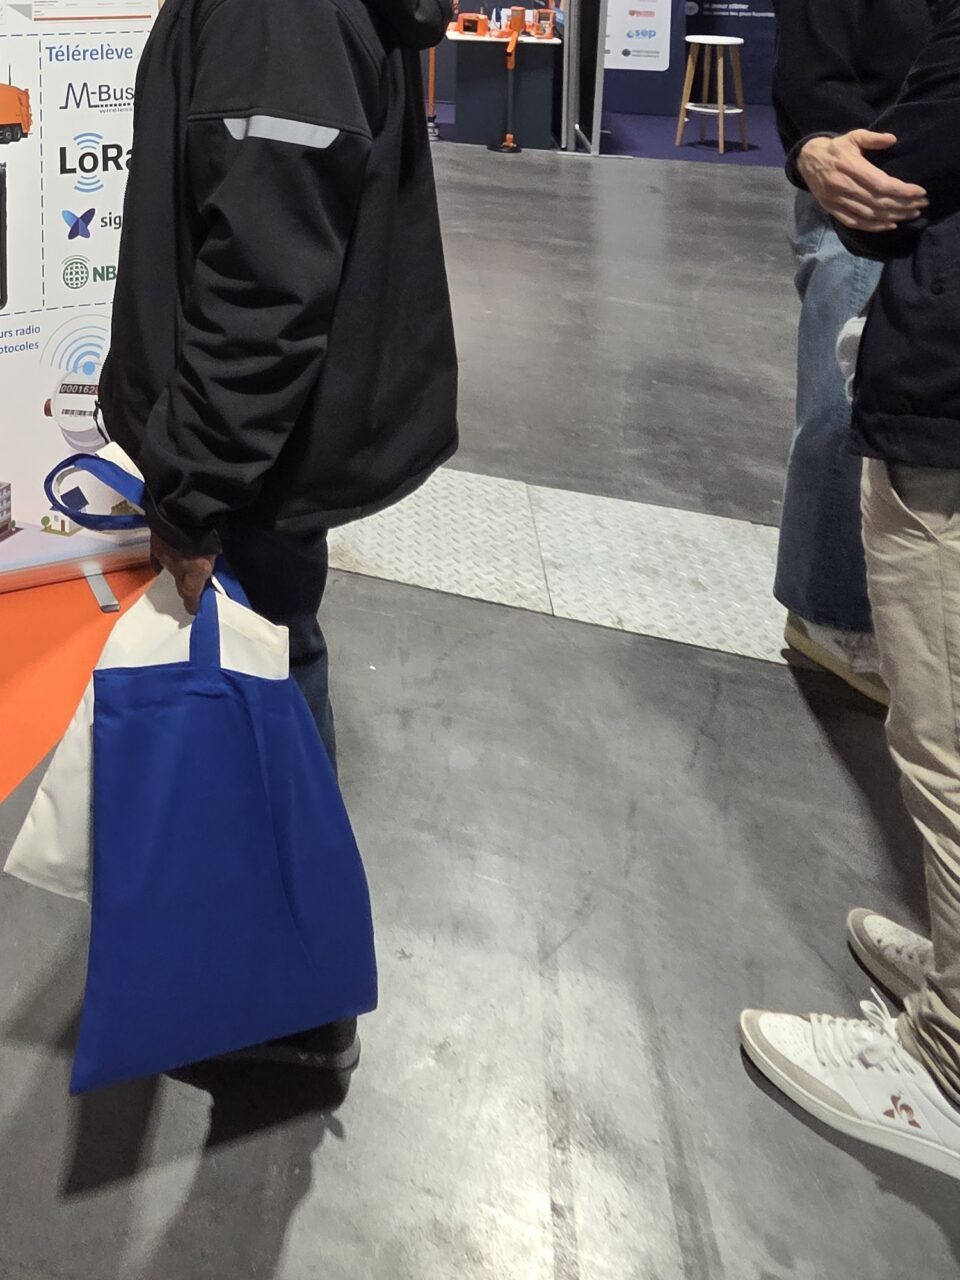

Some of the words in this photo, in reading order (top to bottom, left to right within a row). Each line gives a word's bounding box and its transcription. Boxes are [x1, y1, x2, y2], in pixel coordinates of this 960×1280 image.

[46, 46, 133, 62] Télérelève
[59, 82, 134, 109] M-Bus
[100, 211, 121, 229] sig
[93, 265, 116, 282] NB
[16, 325, 41, 336] radio
